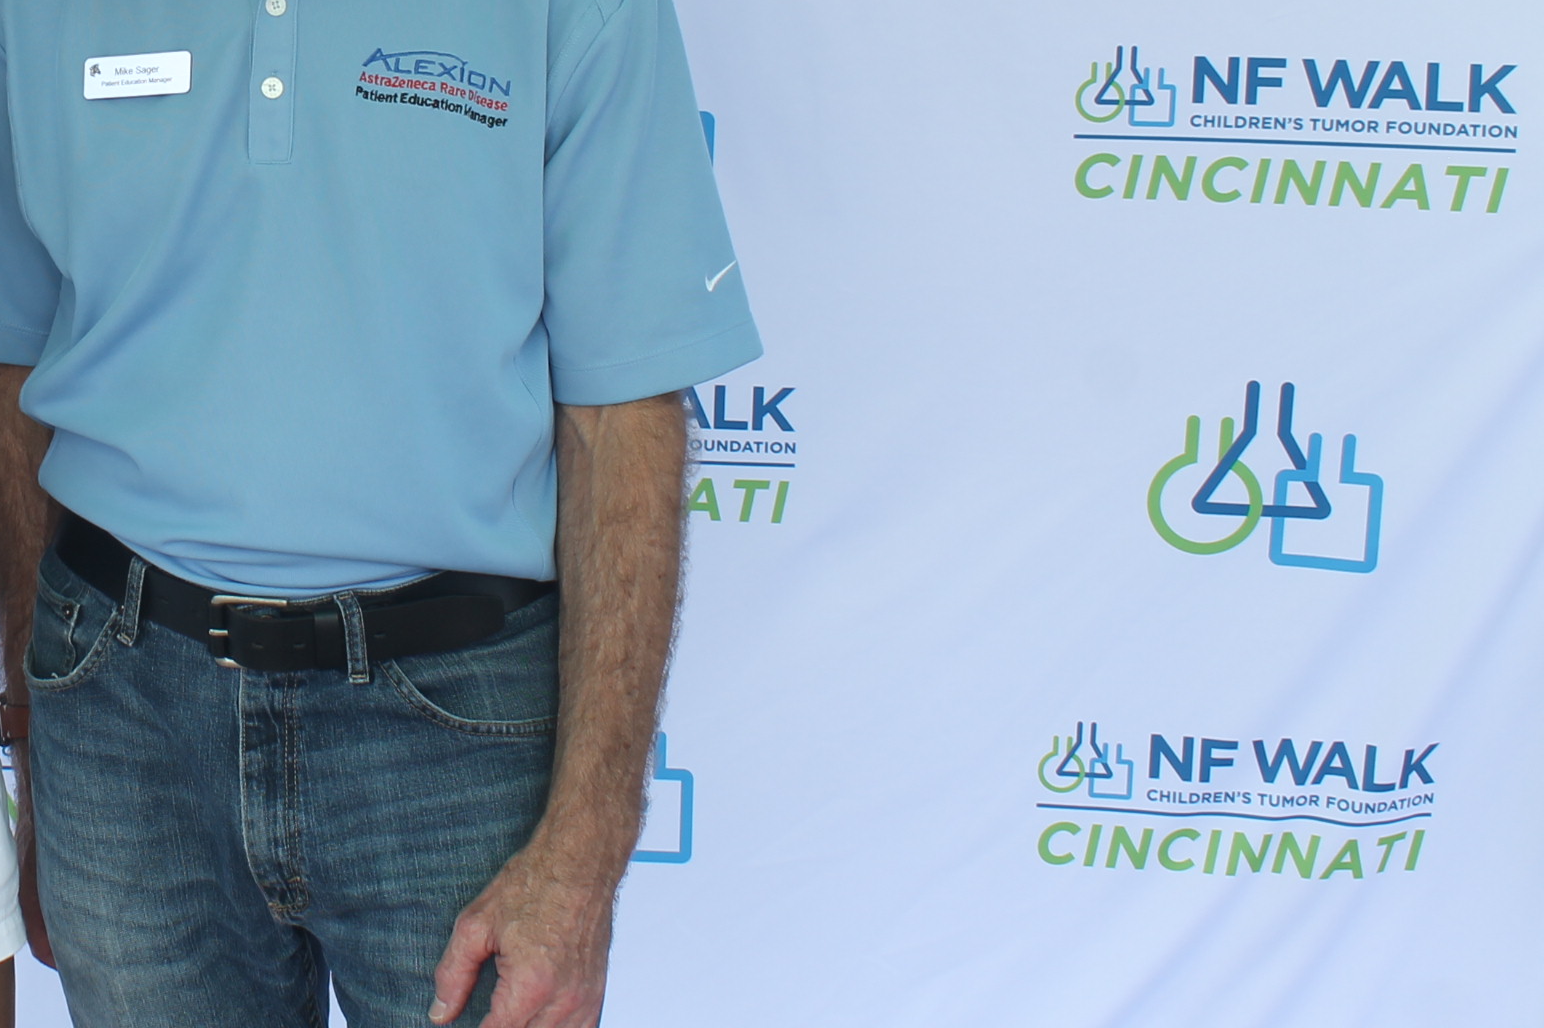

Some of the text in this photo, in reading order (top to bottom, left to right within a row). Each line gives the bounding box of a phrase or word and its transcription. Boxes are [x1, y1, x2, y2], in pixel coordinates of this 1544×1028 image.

[115, 67, 133, 75] Mike
[360, 71, 508, 111] AstraZeneca Rare Disease
[362, 48, 510, 96] ALEXION
[1192, 56, 1517, 114] NF WALK
[356, 86, 398, 103] Patient
[400, 93, 462, 114] Education
[1190, 115, 1518, 138] CHILDREN'S TUMOR FOUNDATION
[1074, 153, 1509, 213] CINCINNATI
[1149, 734, 1439, 793] NF WALK
[1146, 790, 1434, 815] CHILDREN'S TUMOR FOUNDATION
[1037, 822, 1426, 880] CINCINNATI
